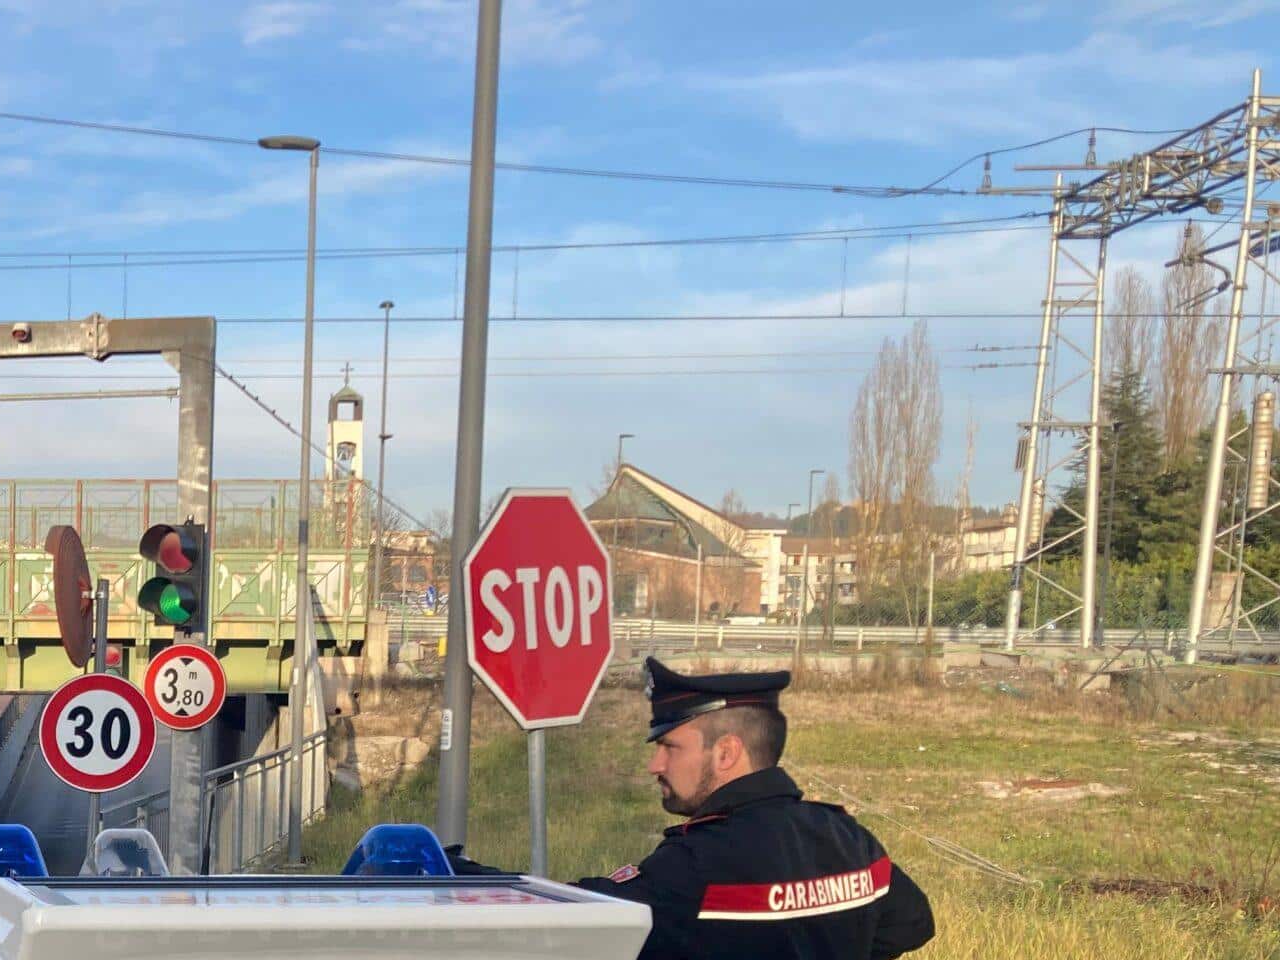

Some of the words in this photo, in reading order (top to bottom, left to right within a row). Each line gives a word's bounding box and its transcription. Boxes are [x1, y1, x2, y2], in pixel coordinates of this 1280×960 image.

[480, 565, 603, 653] STOP
[65, 705, 132, 760] 30
[768, 868, 874, 911] CARABINIERI
